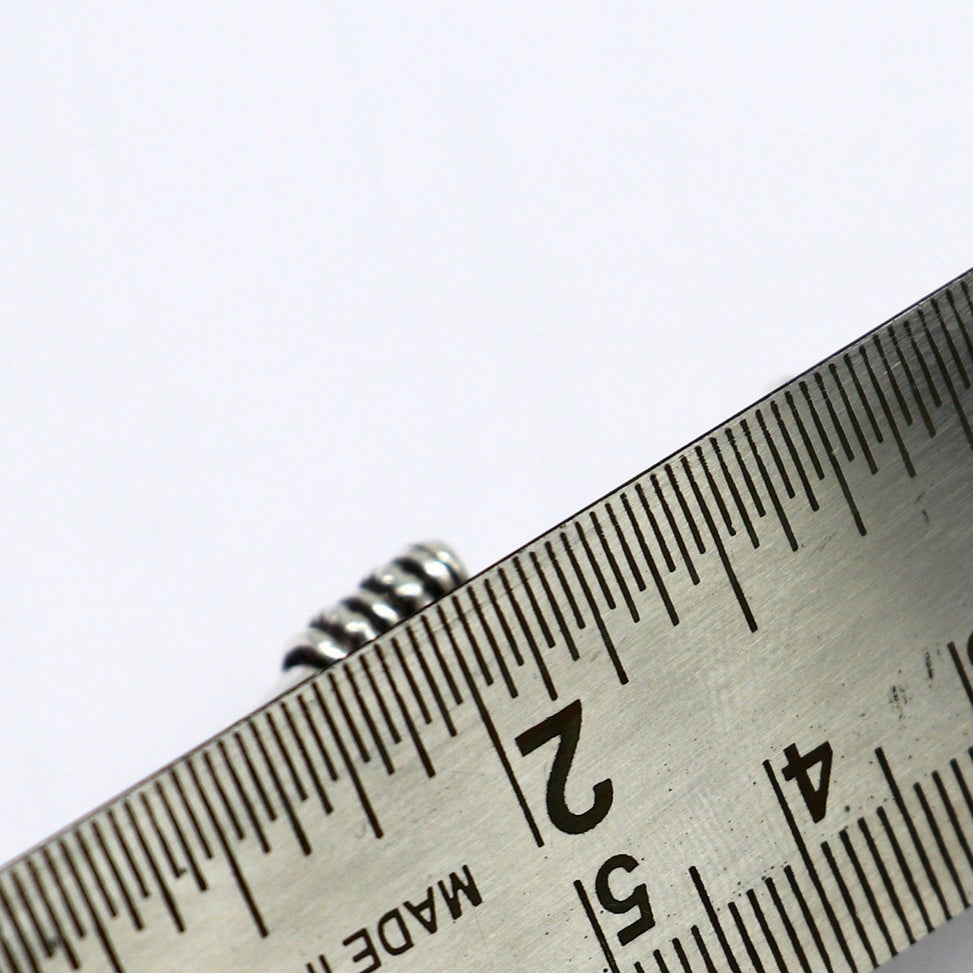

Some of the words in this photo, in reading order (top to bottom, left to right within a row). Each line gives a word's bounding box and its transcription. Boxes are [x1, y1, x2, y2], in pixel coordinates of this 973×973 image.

[515, 699, 613, 834] 2
[782, 740, 833, 823] 4
[595, 854, 656, 946] 5
